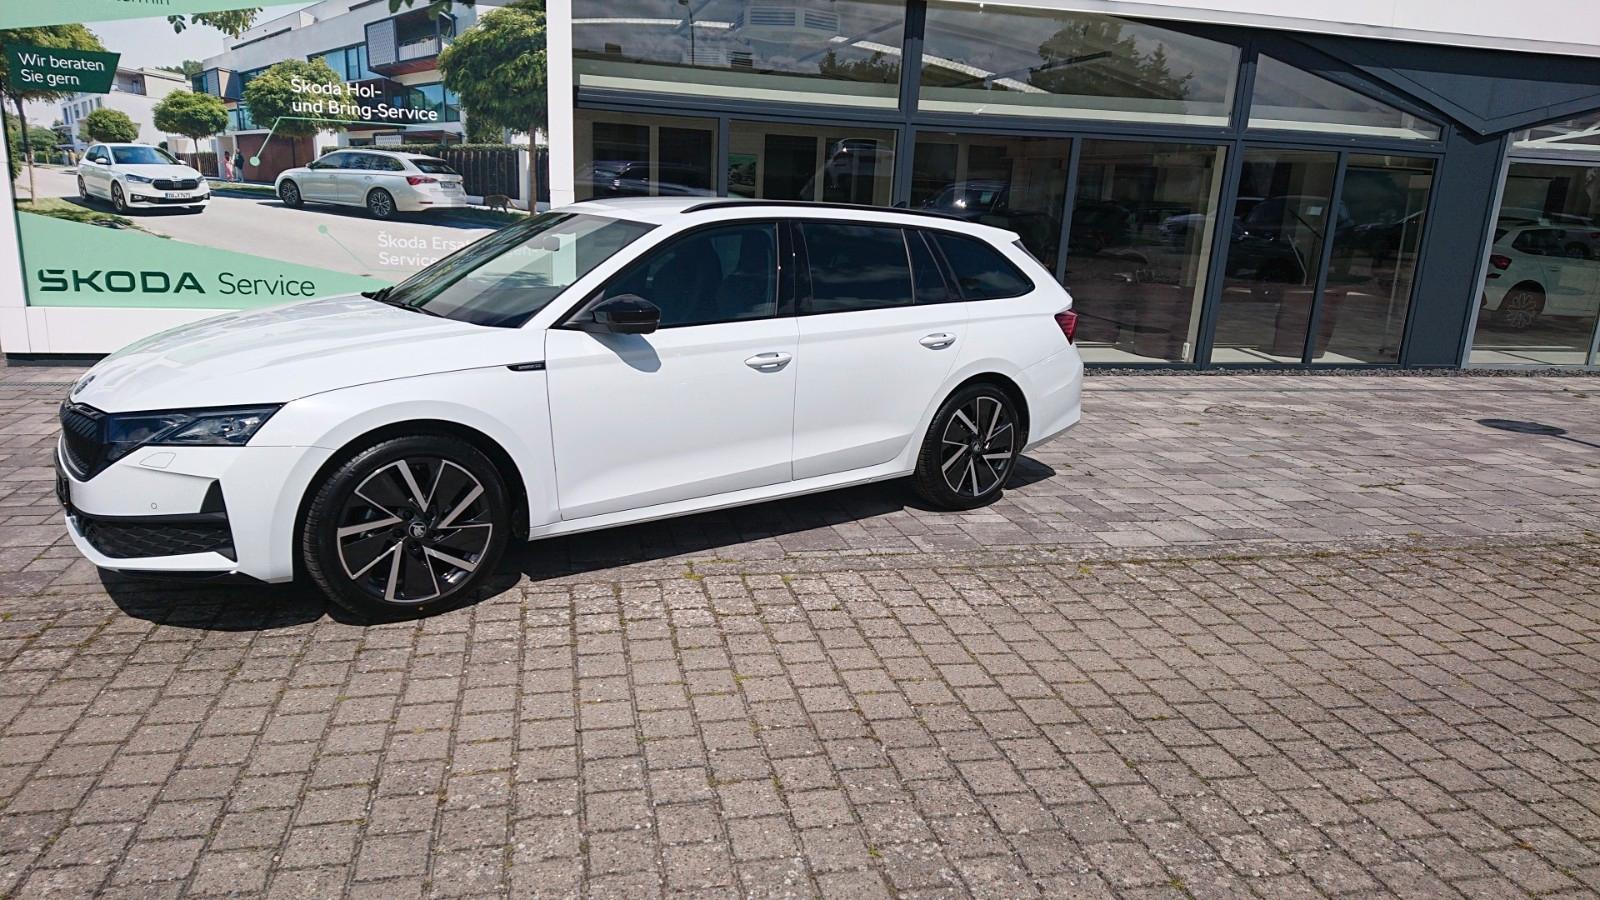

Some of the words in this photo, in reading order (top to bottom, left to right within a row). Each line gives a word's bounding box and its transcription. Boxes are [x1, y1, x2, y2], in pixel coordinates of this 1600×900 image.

[18, 52, 46, 67] Wir
[49, 55, 105, 71] beraten
[21, 69, 43, 82] Sie
[47, 73, 80, 86] gern
[290, 73, 342, 96] Škoda
[347, 82, 382, 98] Hol-
[292, 99, 323, 114] und
[328, 101, 438, 121] Bring-Service
[377, 230, 427, 250] Škoda
[218, 272, 316, 297] Service
